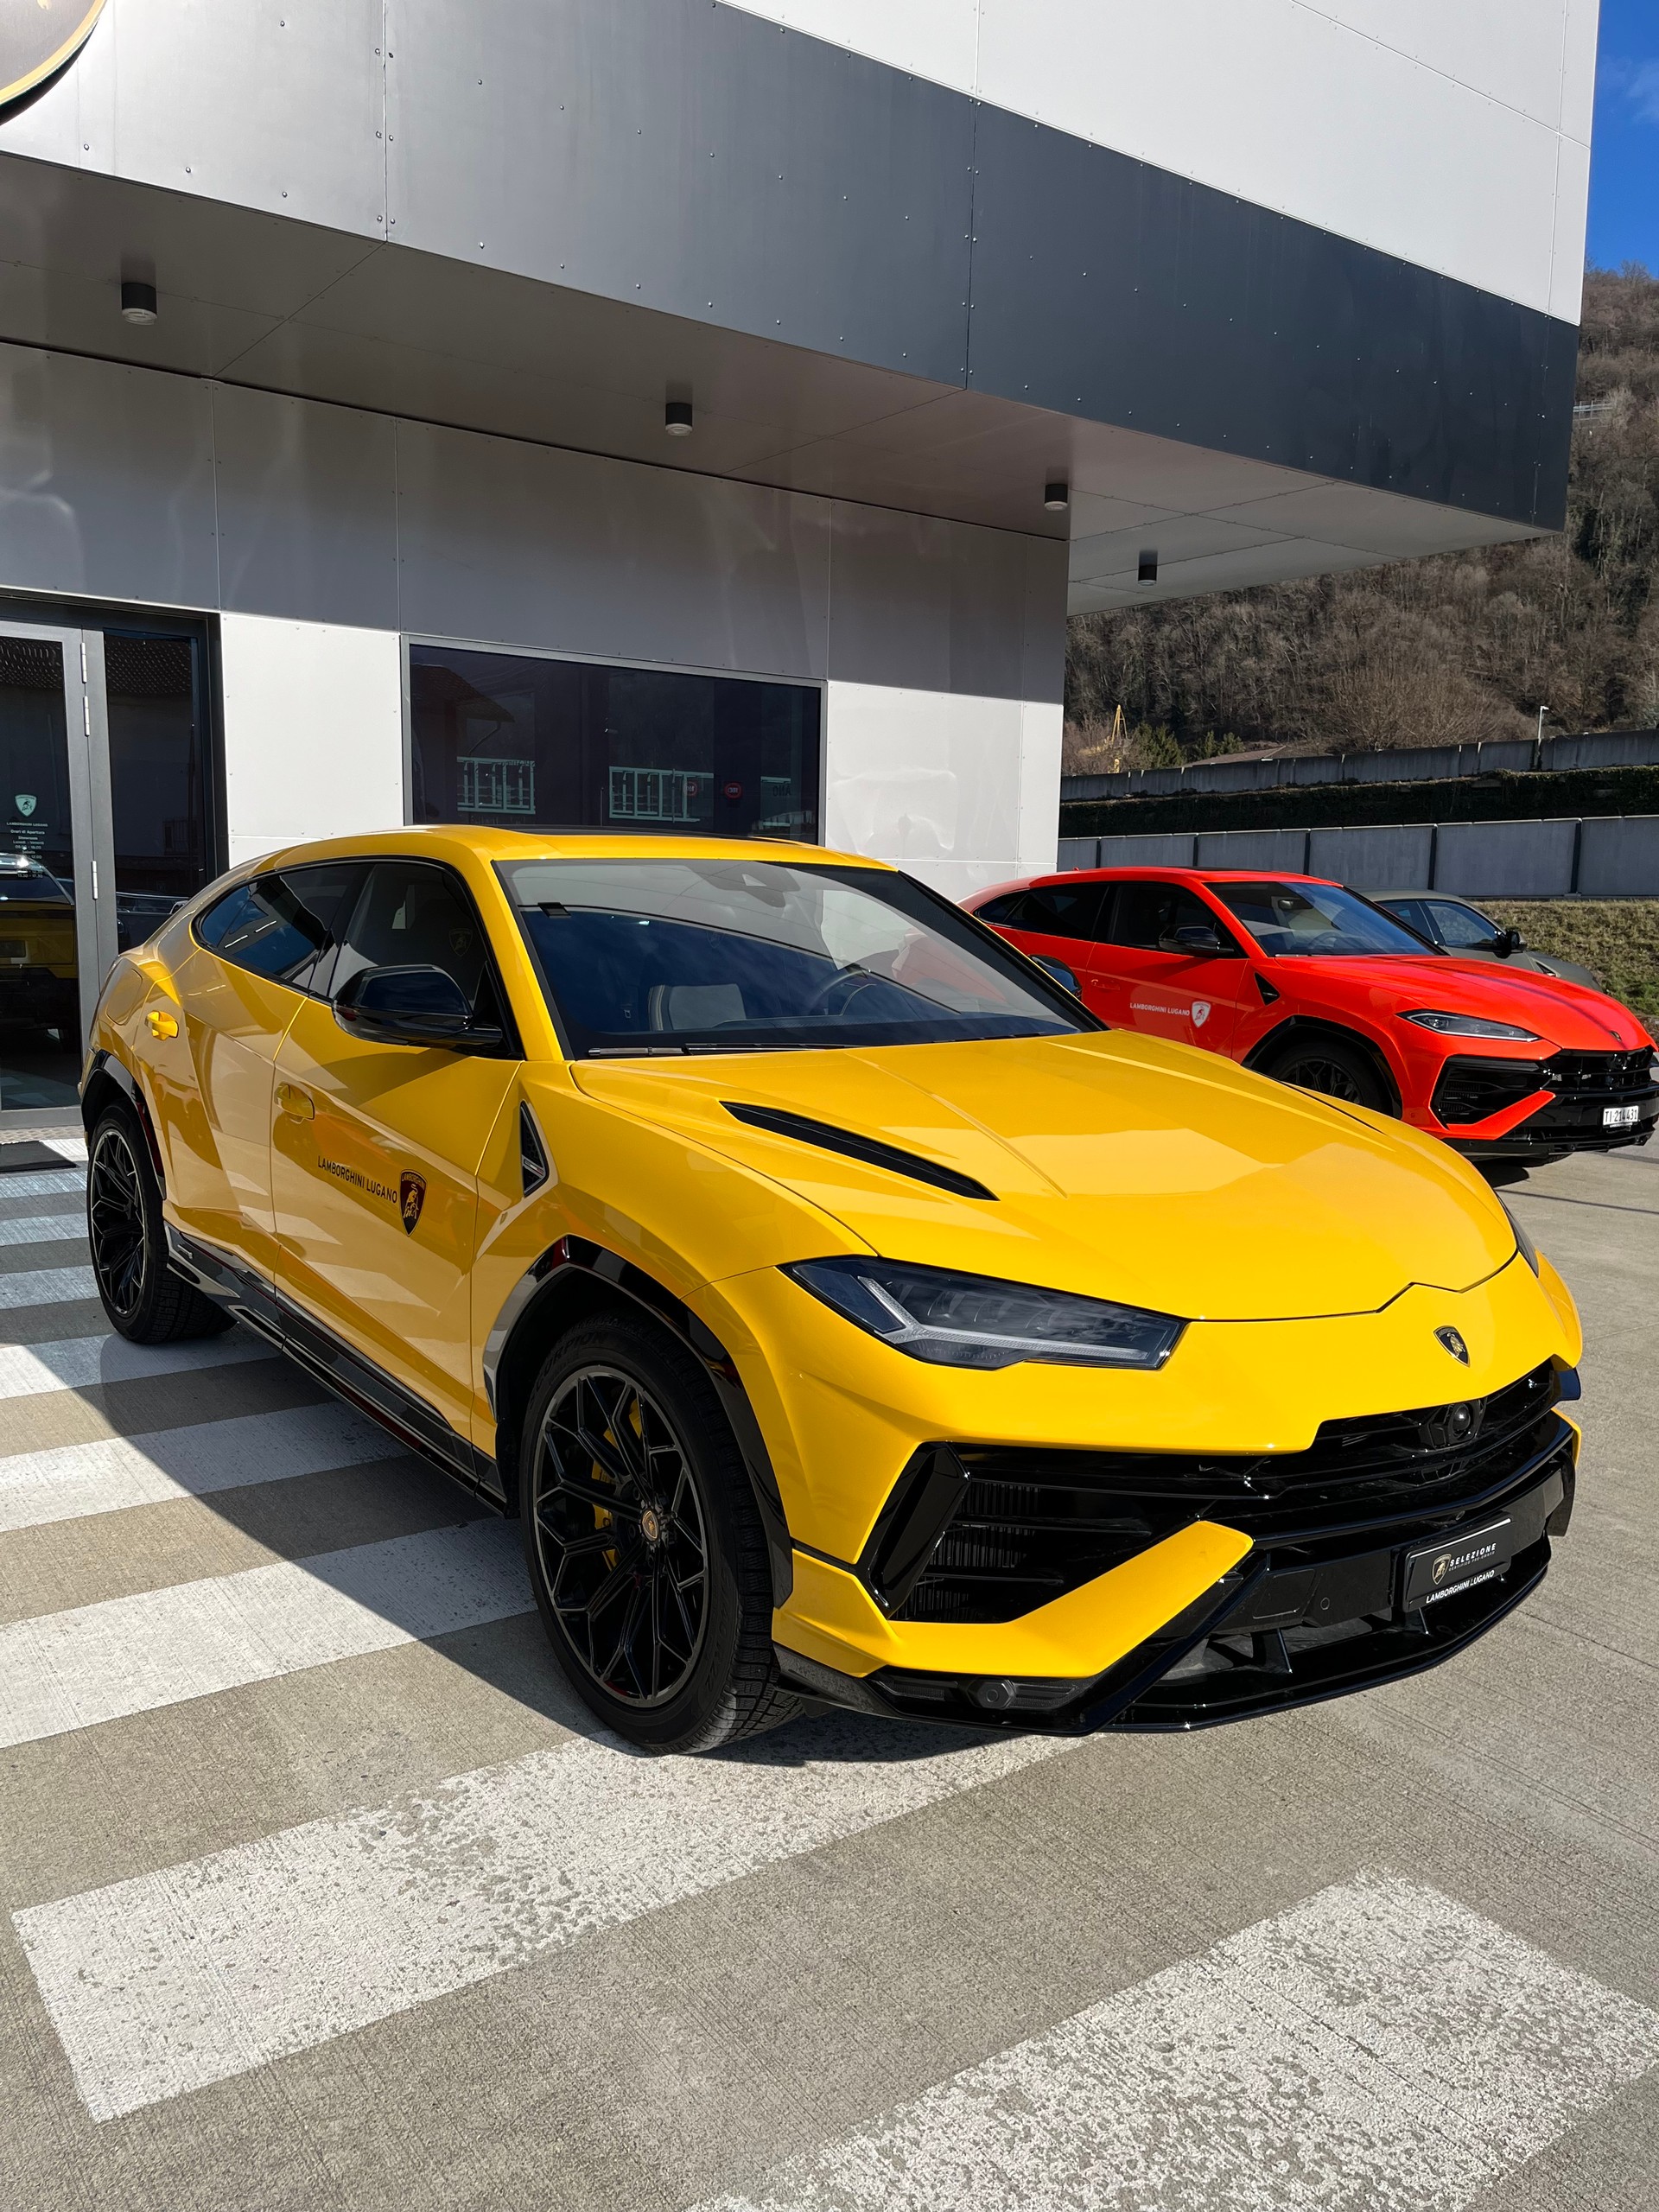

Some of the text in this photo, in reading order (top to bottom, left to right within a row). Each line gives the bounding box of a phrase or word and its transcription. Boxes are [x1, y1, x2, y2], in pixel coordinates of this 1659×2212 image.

[1129, 1002, 1190, 1016] LAMBORGHINI LUGANO
[318, 1155, 397, 1204] LAMBORGHINI LUGANO
[1450, 1542, 1497, 1567] SELEZIONE
[1426, 1569, 1495, 1604] LAMBORGHINI LUGANO
